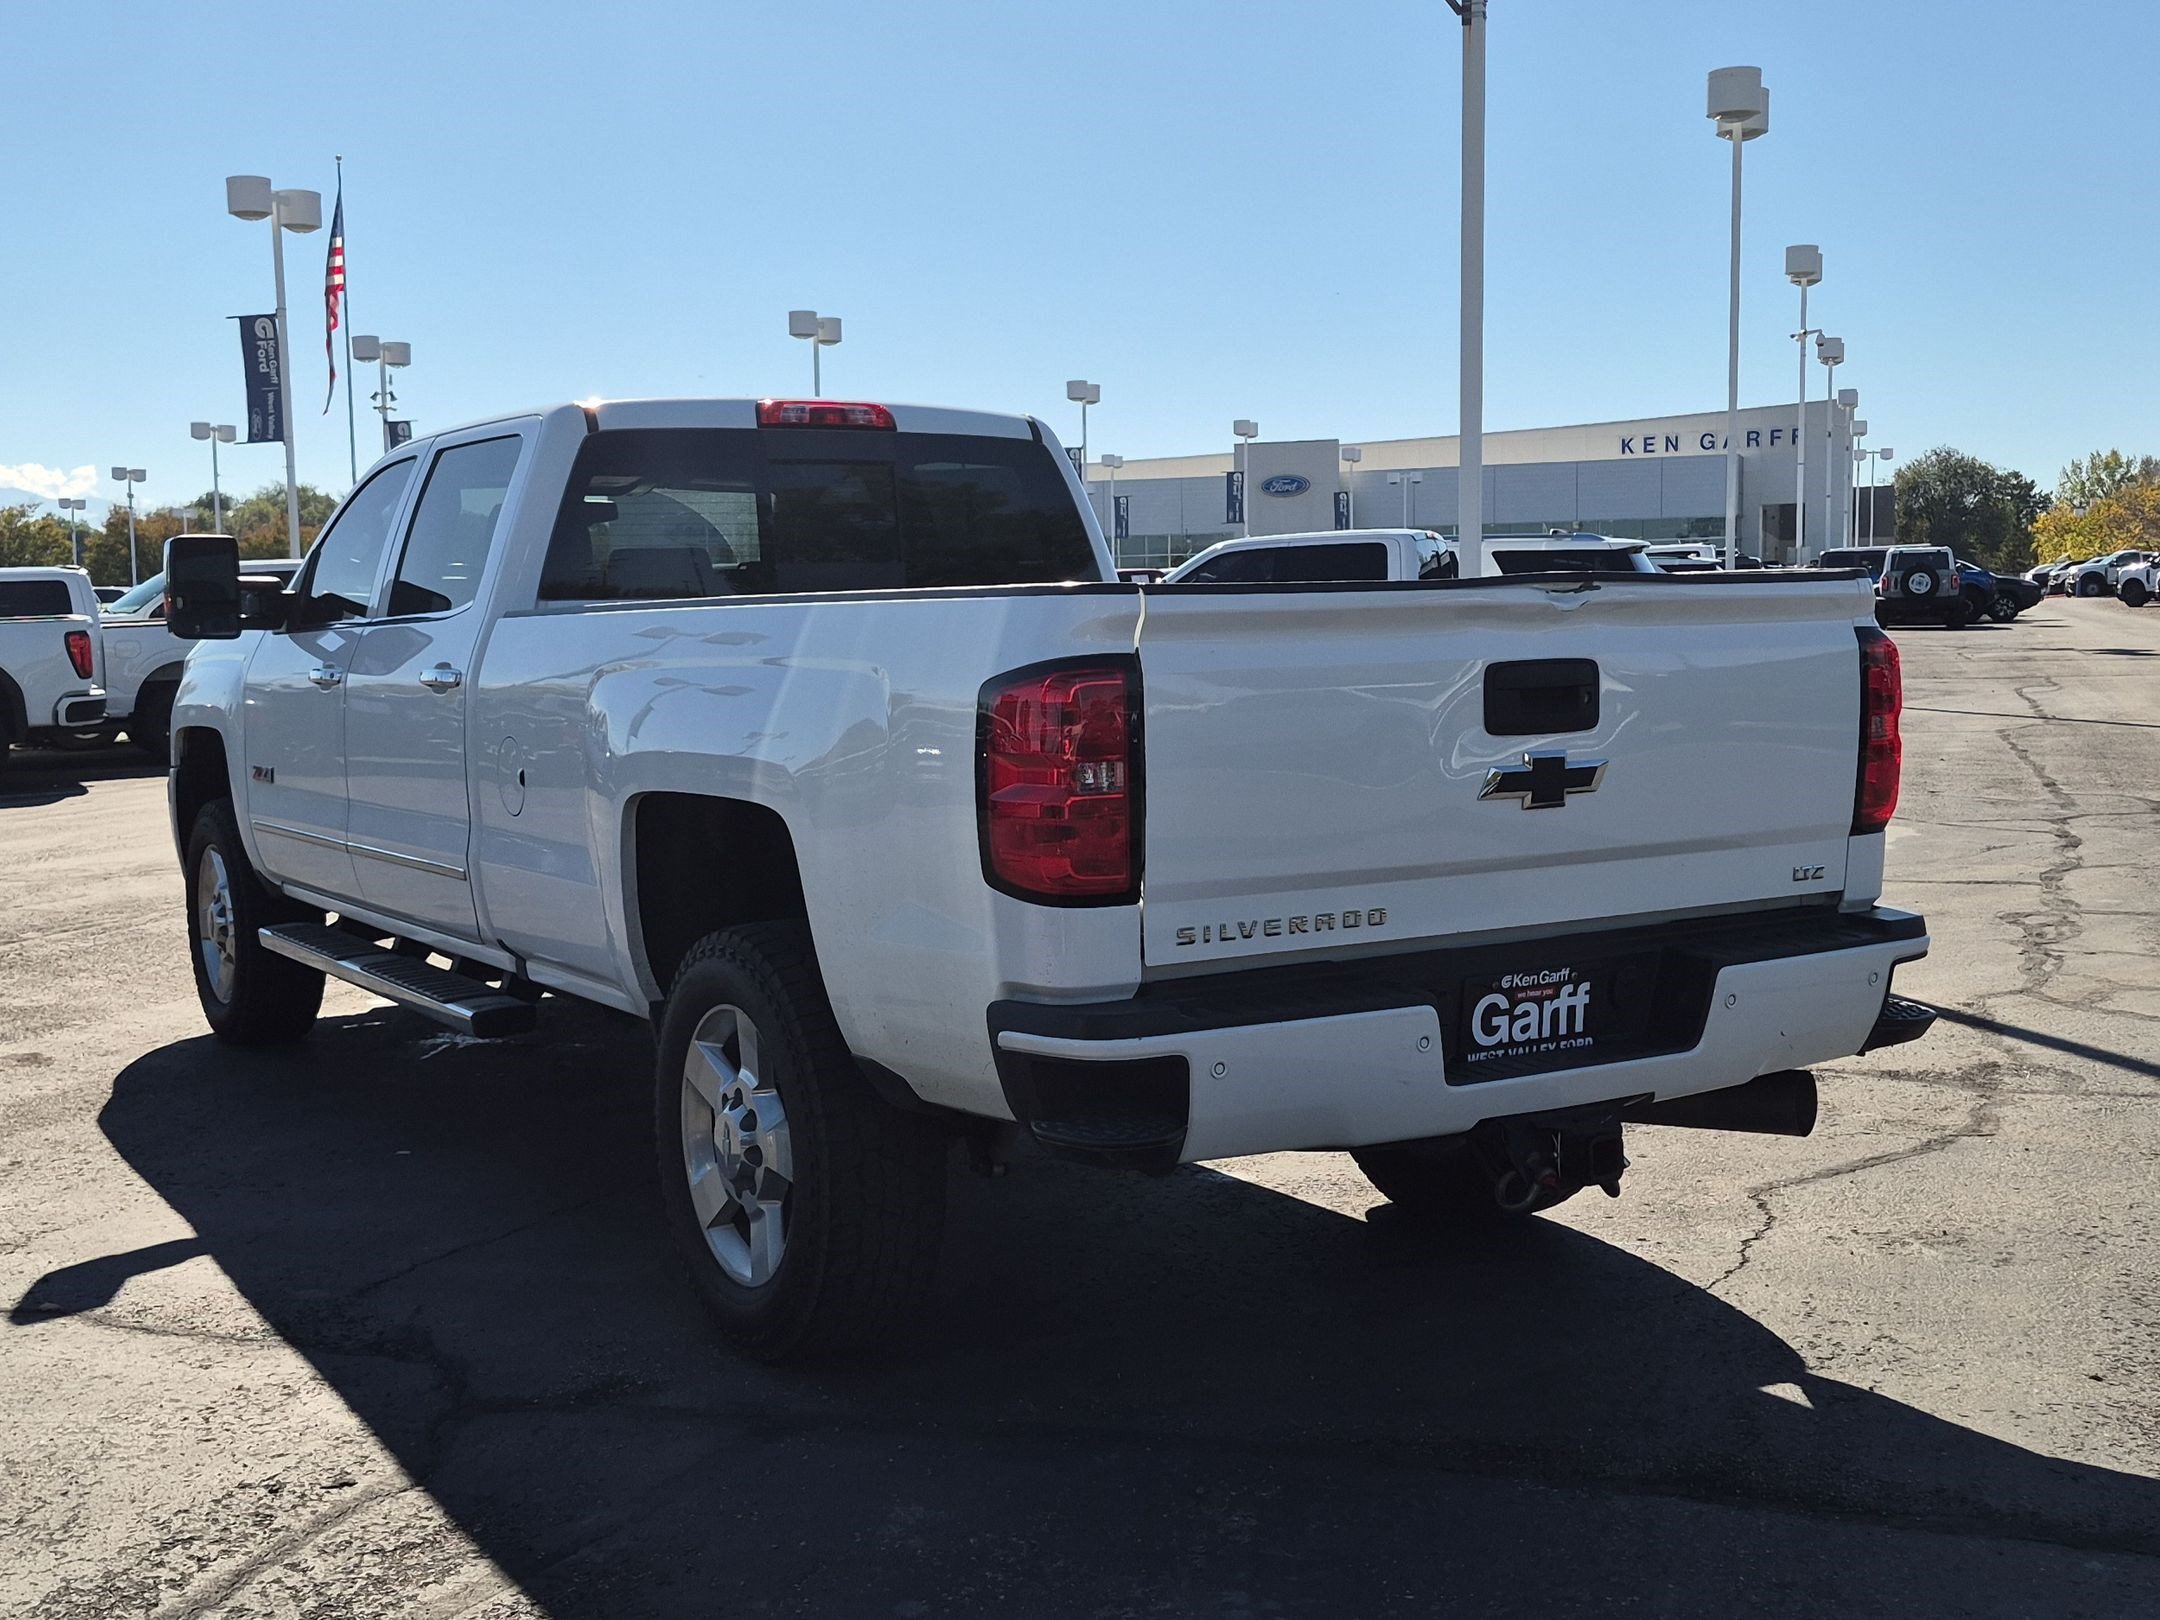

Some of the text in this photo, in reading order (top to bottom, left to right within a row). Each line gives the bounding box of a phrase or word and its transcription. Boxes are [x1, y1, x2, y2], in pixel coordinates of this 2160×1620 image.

[256, 341, 270, 373] Ford
[267, 340, 279, 384] Ken Garff
[1621, 435, 1679, 455] KEN
[1269, 479, 1298, 493] Ford
[1175, 907, 1388, 947] SILVERADO
[1512, 973, 1538, 988] Ken
[1539, 967, 1571, 984] Garff
[1471, 981, 1591, 1047] Garff
